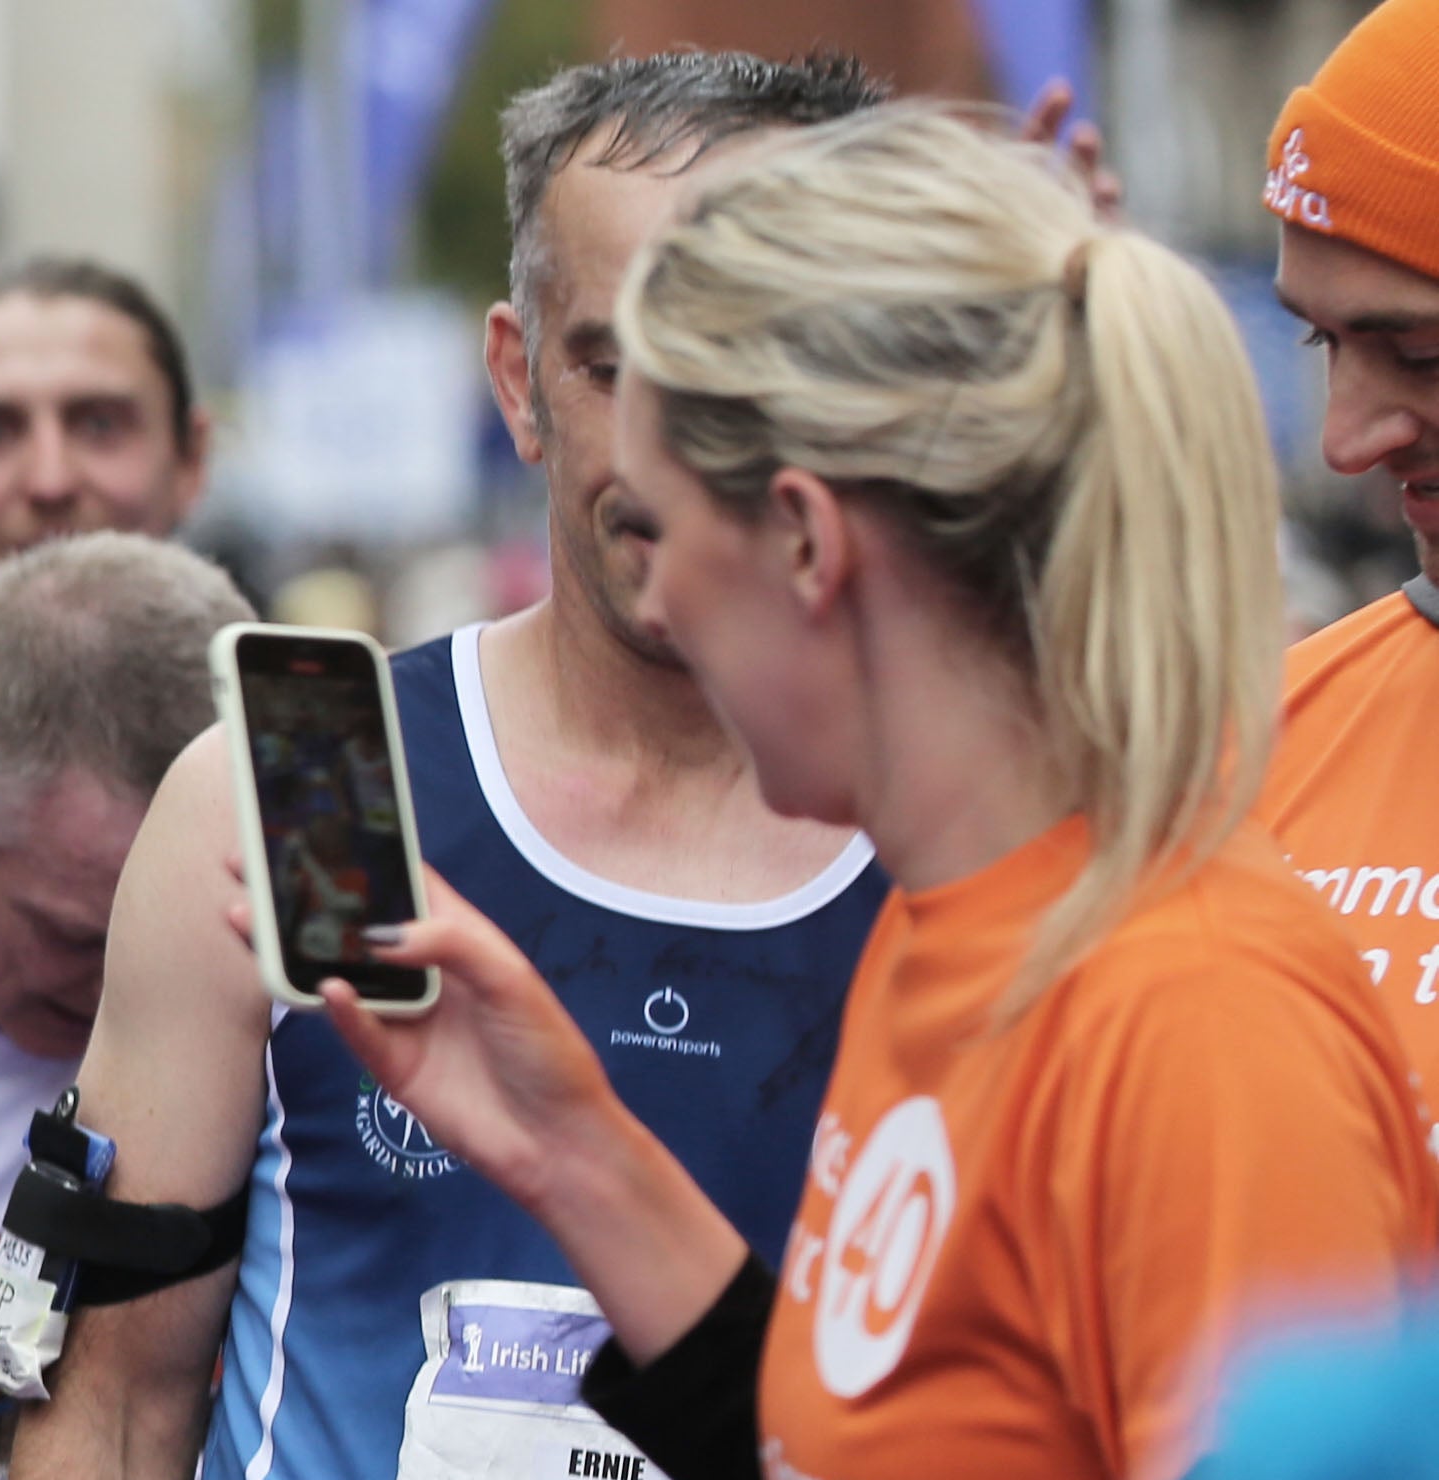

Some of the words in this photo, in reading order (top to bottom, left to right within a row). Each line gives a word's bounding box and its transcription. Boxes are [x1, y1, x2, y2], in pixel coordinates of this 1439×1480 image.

[610, 1029, 721, 1058] poweronsports
[491, 1341, 549, 1371] Irish
[555, 1347, 593, 1377] Lif
